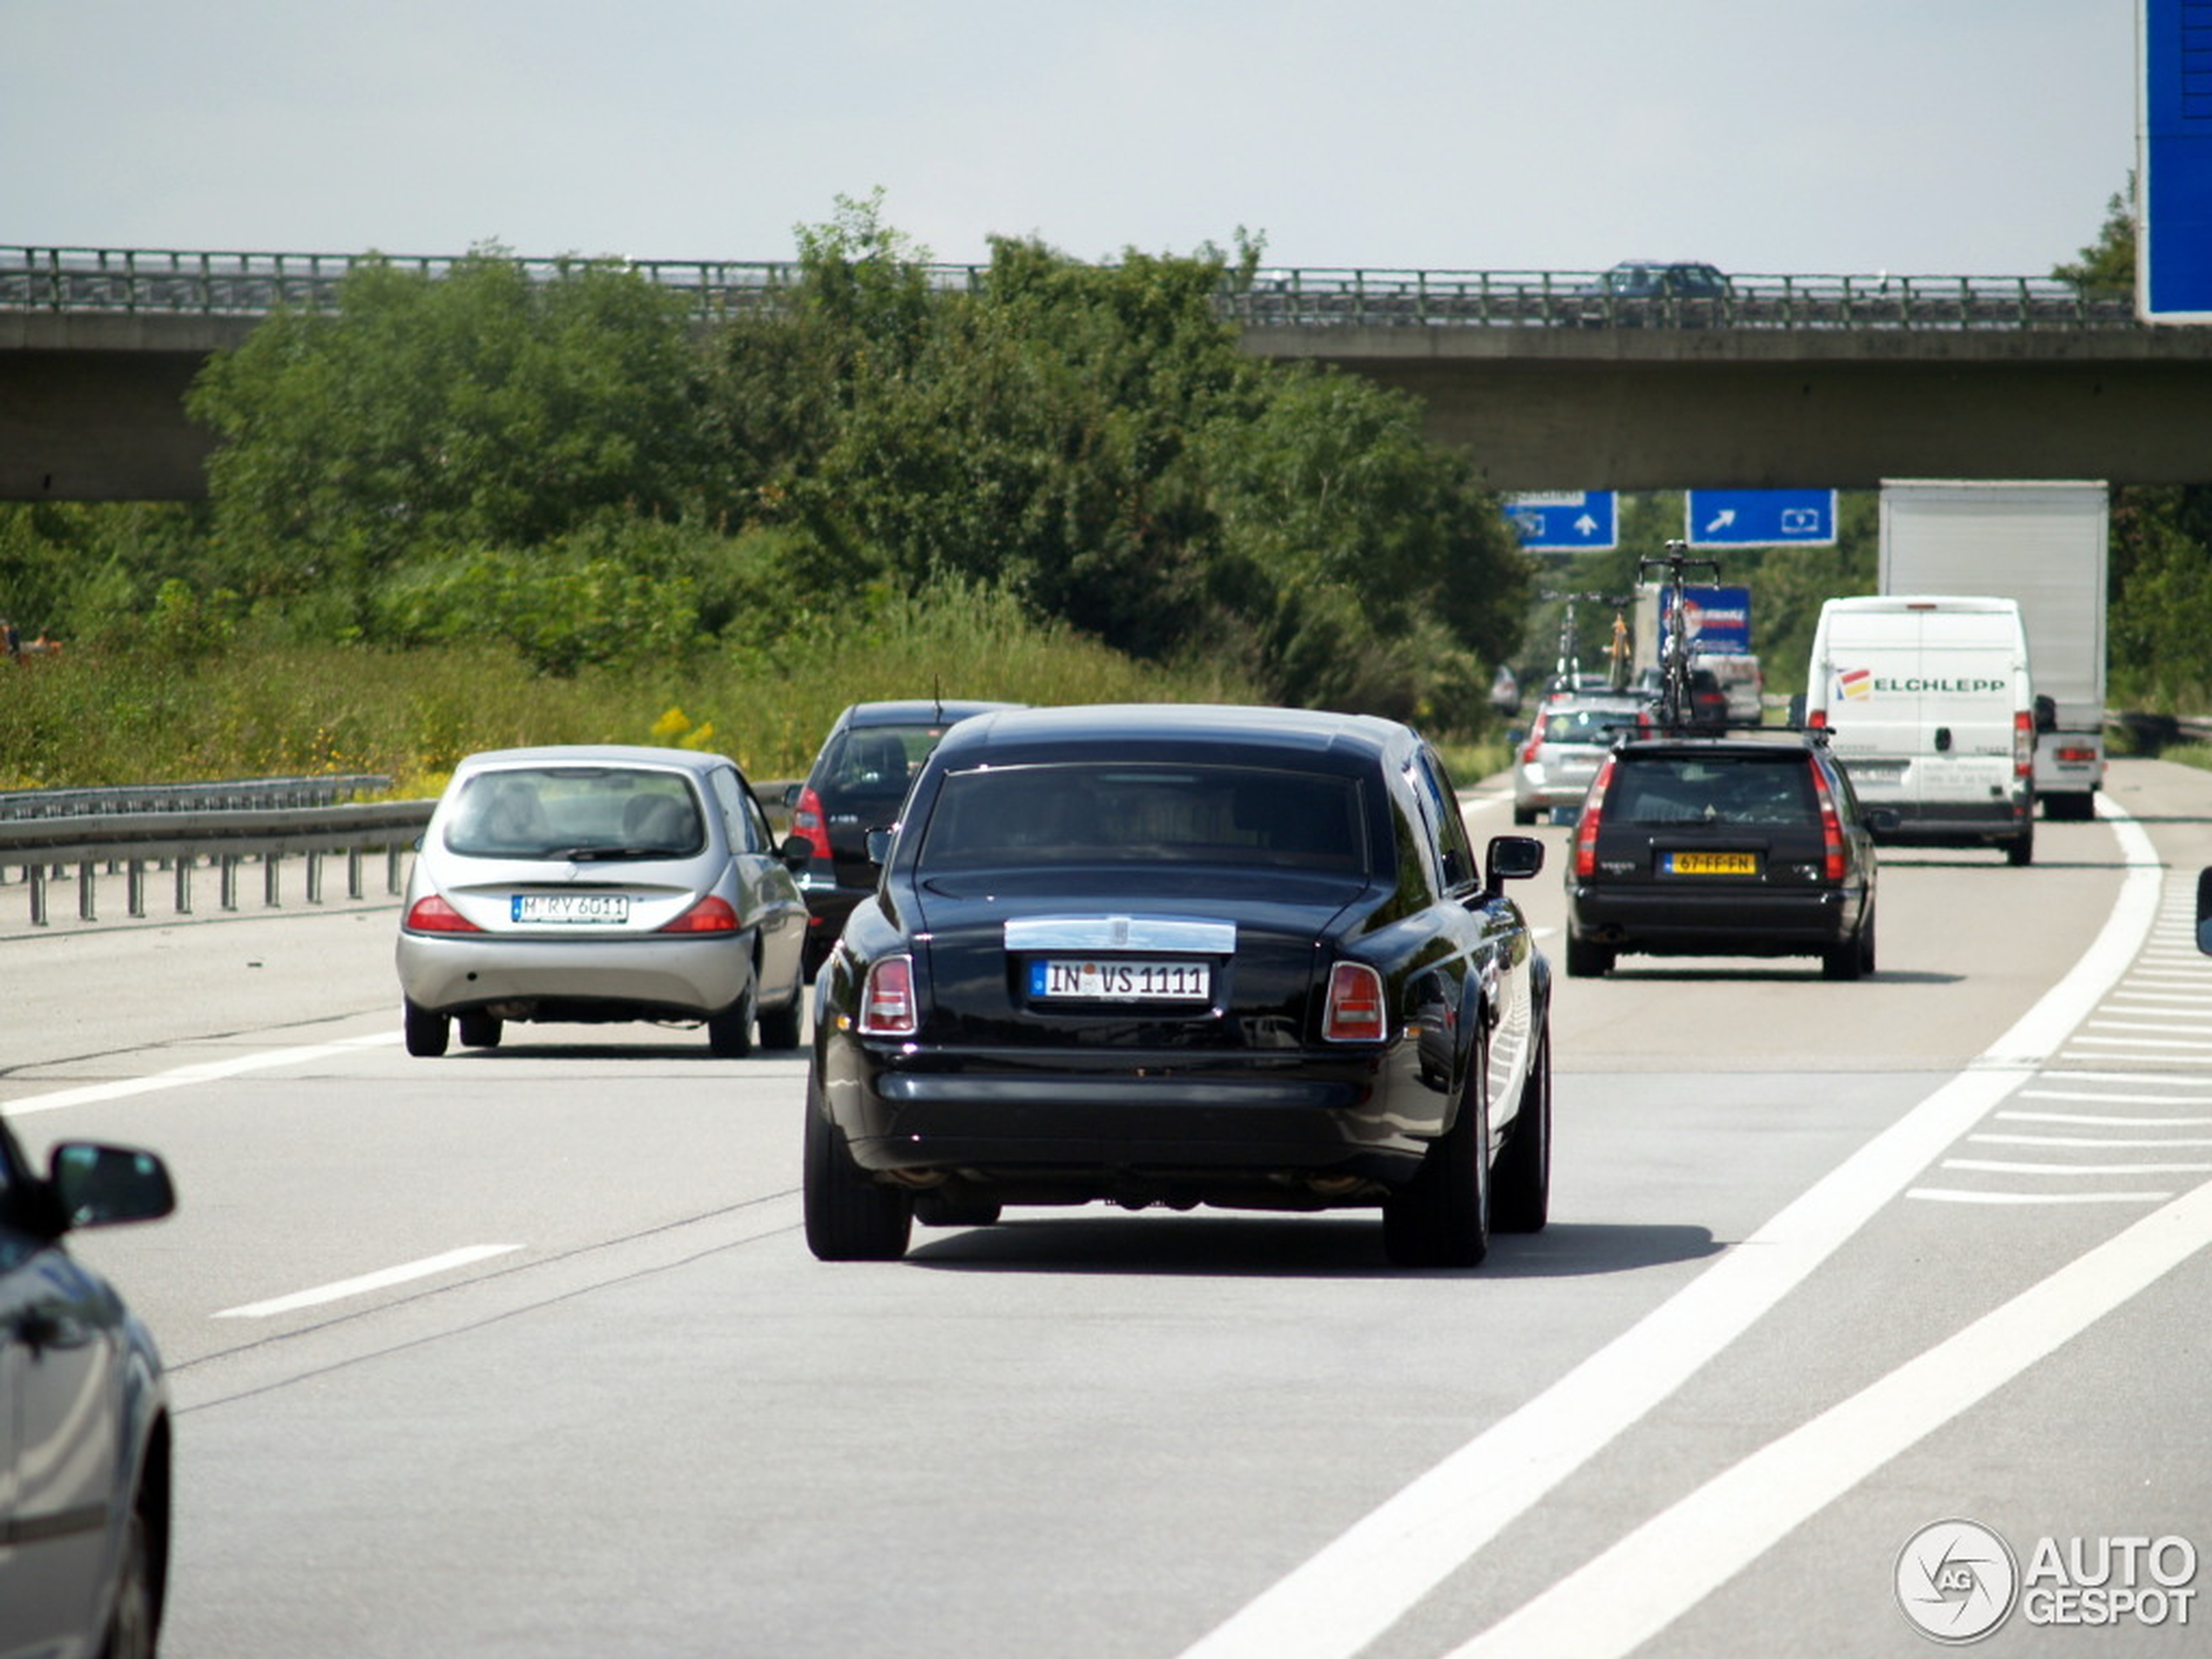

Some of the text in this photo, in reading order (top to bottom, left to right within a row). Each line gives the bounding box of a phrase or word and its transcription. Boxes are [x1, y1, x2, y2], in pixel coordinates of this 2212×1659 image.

[1874, 678, 2006, 691] ELCHLEPP
[524, 898, 536, 914] M
[578, 898, 623, 914] 6011
[1051, 965, 1203, 994] IN VS 1111
